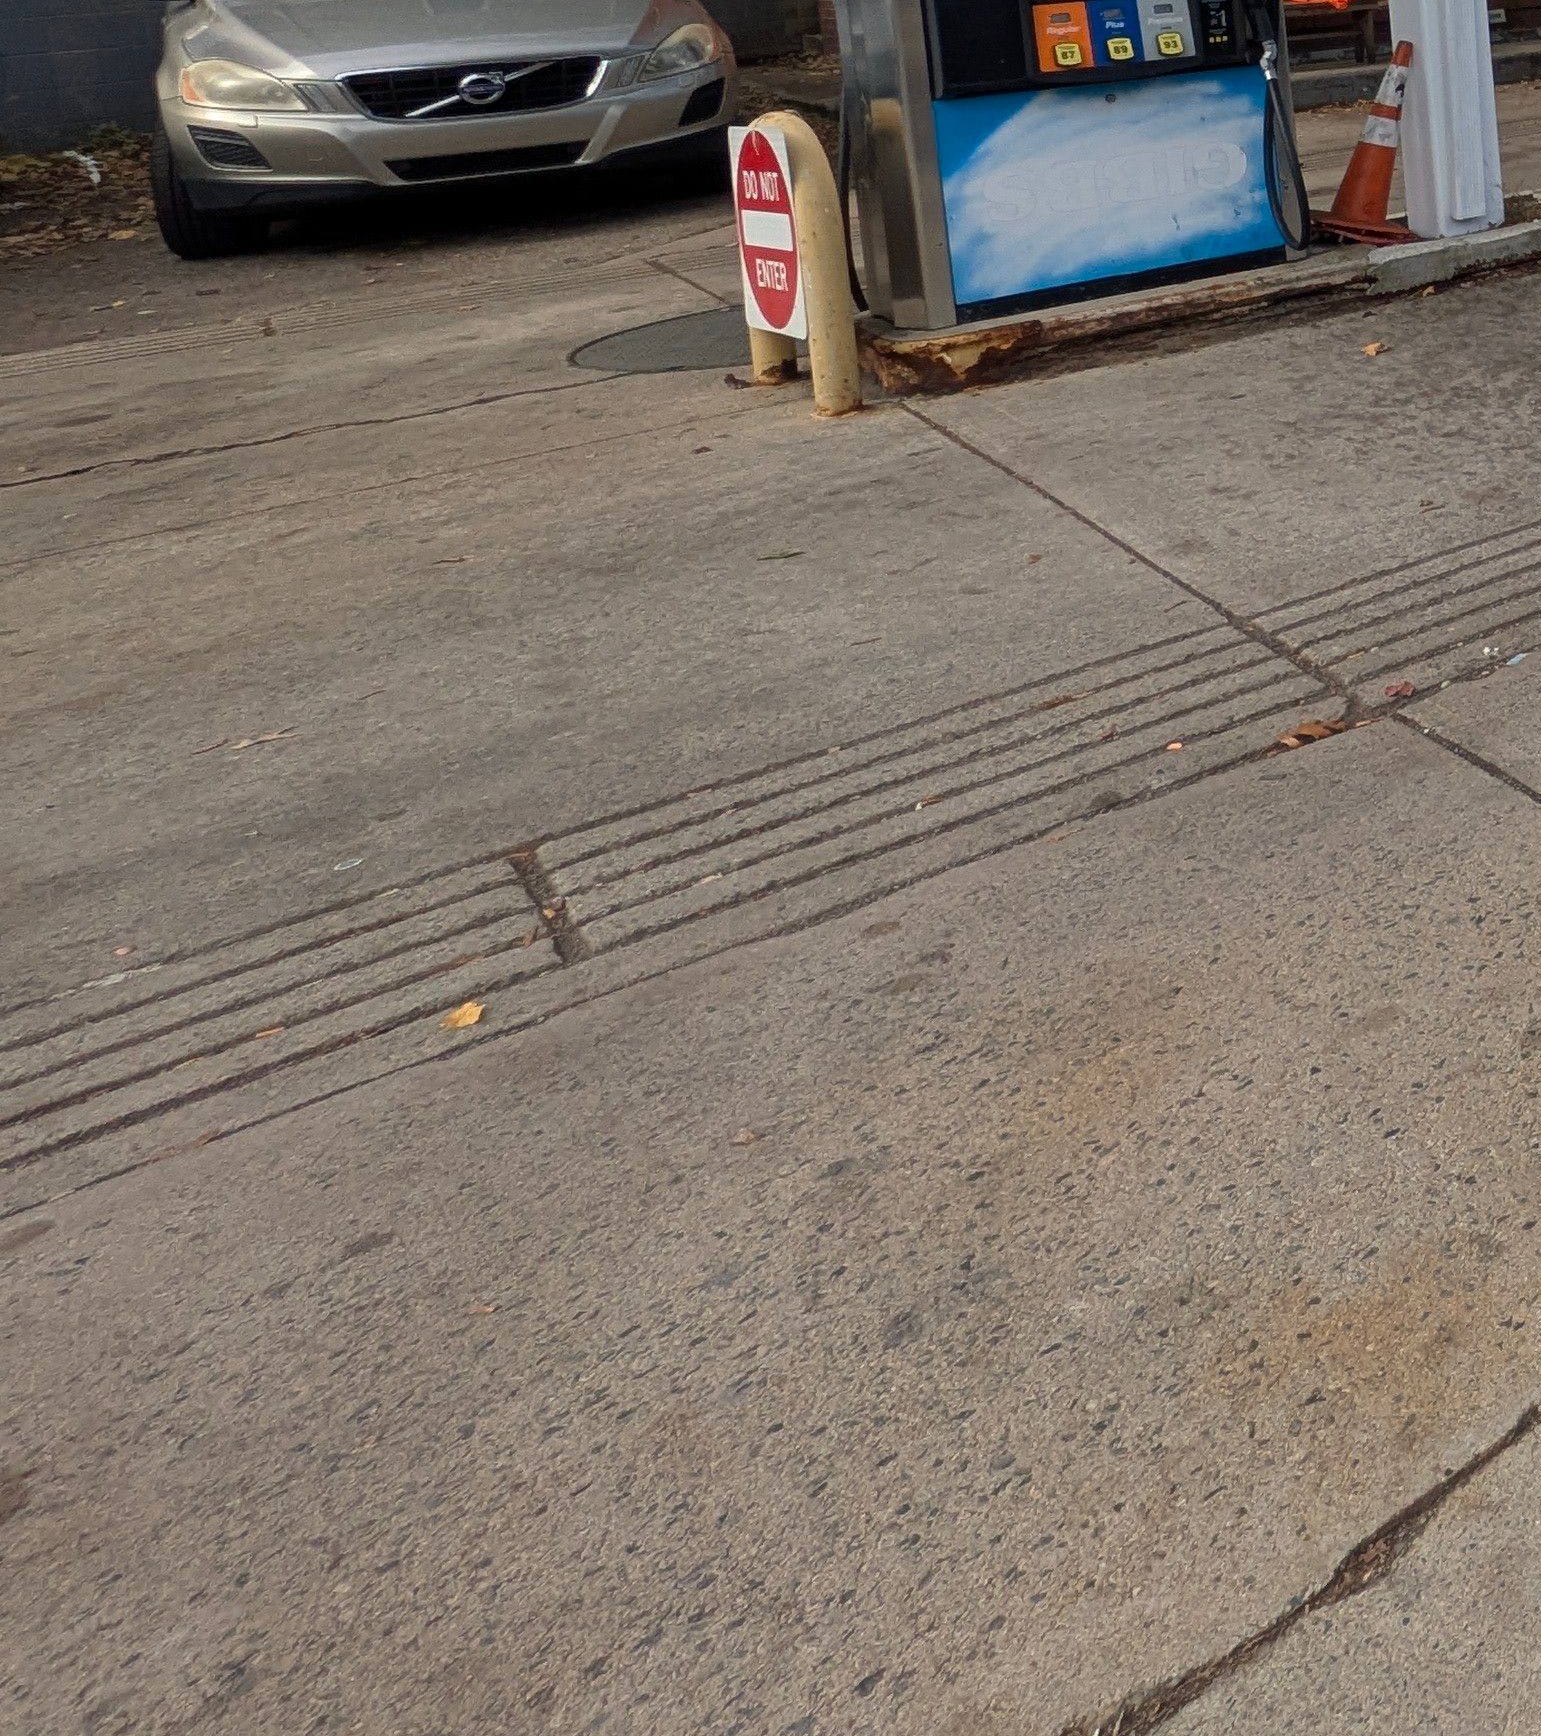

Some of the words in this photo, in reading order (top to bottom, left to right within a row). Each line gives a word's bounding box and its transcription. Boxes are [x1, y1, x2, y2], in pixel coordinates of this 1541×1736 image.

[1112, 44, 1129, 56] 89
[1162, 38, 1179, 50] 93
[1060, 50, 1076, 61] 87
[742, 170, 758, 201] DO
[759, 171, 780, 202] NOT
[755, 258, 789, 292] ENTER
